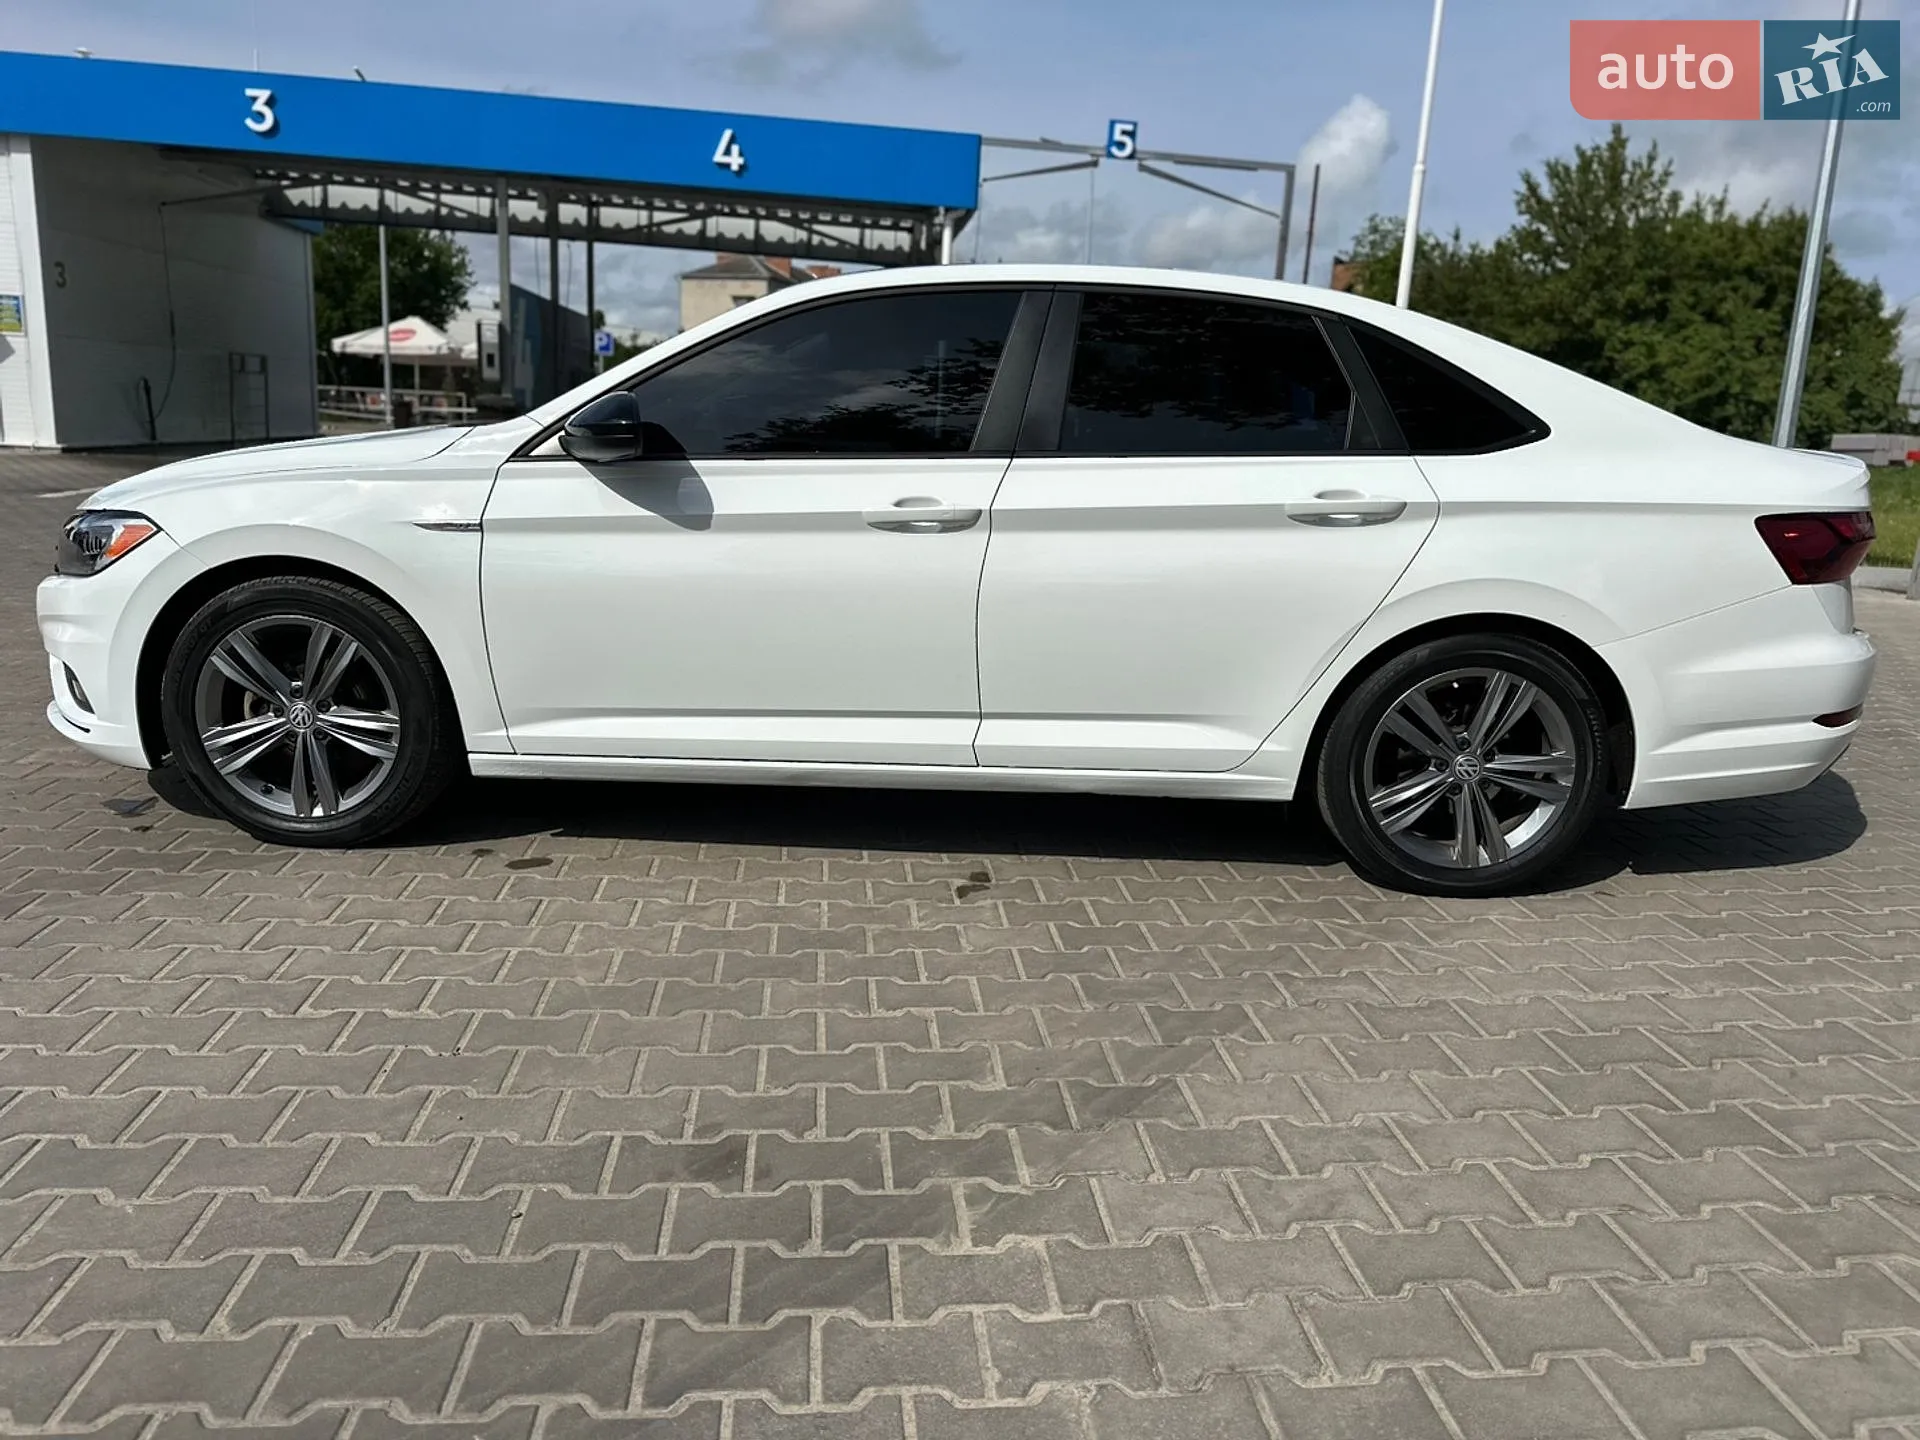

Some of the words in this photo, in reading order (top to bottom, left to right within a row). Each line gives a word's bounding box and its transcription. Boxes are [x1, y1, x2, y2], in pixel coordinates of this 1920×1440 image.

[244, 87, 274, 132] 3
[712, 128, 744, 171] 4
[1110, 122, 1134, 158] 5
[54, 261, 67, 289] 3
[594, 331, 609, 353] P
